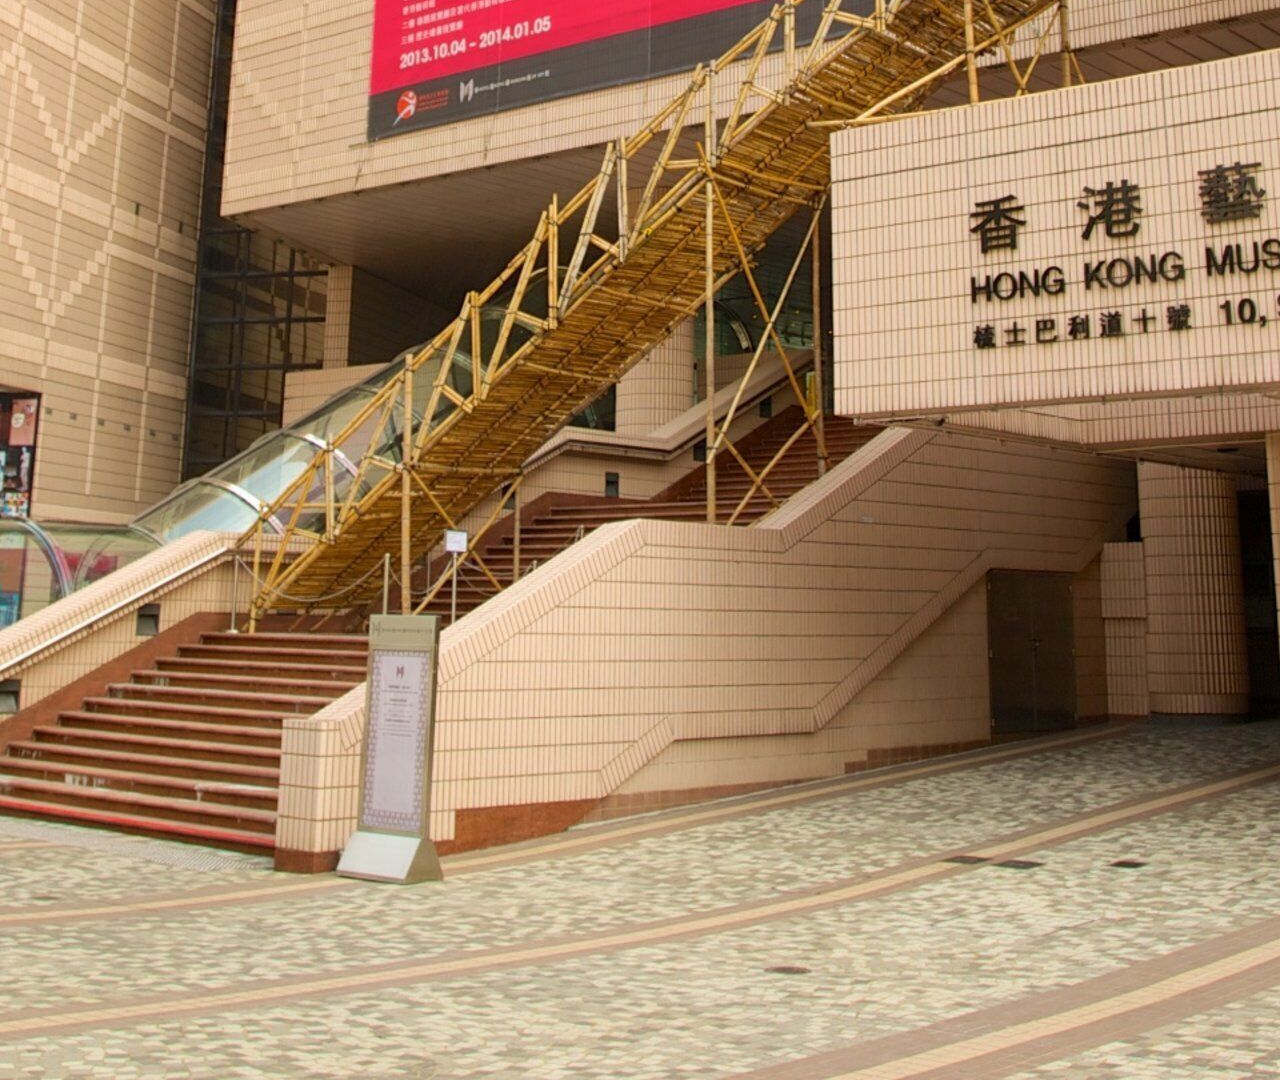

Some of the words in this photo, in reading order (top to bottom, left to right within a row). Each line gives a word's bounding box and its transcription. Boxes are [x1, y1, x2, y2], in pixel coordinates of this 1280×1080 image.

[399, 37, 467, 70] 2013.10.04
[479, 14, 552, 50] 2014.01.05
[970, 265, 1066, 304] HONG
[1083, 251, 1186, 292] KONG
[972, 304, 1193, 351] 梳士巴利道十號
[1219, 297, 1268, 328] 10,
